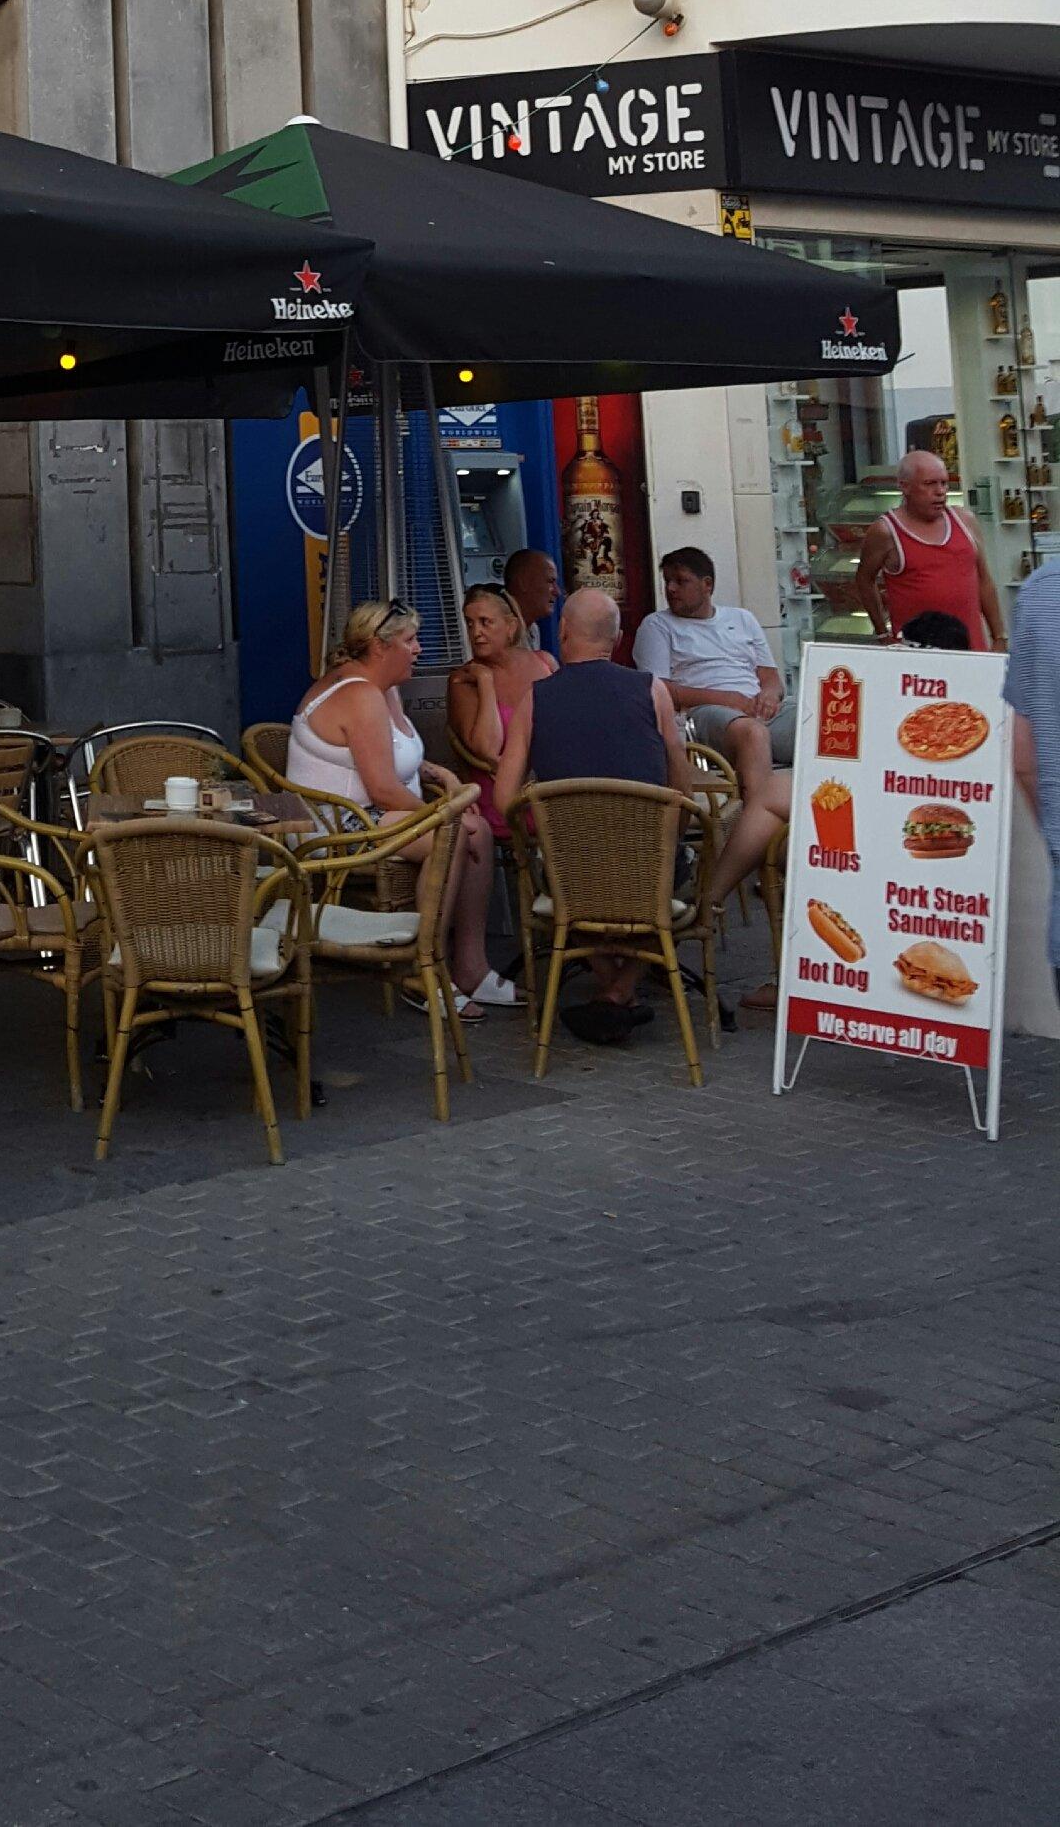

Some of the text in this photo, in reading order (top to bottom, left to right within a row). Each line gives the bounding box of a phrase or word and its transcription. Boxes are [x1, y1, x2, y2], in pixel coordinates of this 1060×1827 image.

[426, 84, 705, 161] VINTAGE
[770, 86, 1059, 171] VINTAGE MY STORE
[608, 150, 705, 175] MY STORE
[270, 298, 355, 320] Heineke
[223, 337, 315, 362] Heineken
[821, 340, 888, 361] Heineken
[901, 673, 948, 699] Pizza
[884, 770, 993, 803] Hamburger
[809, 844, 861, 872] Chips
[885, 881, 990, 917] Pork Steak
[888, 909, 985, 943] Sandwich
[799, 957, 869, 992] Hot Dog
[817, 1012, 958, 1058] We serve all day
